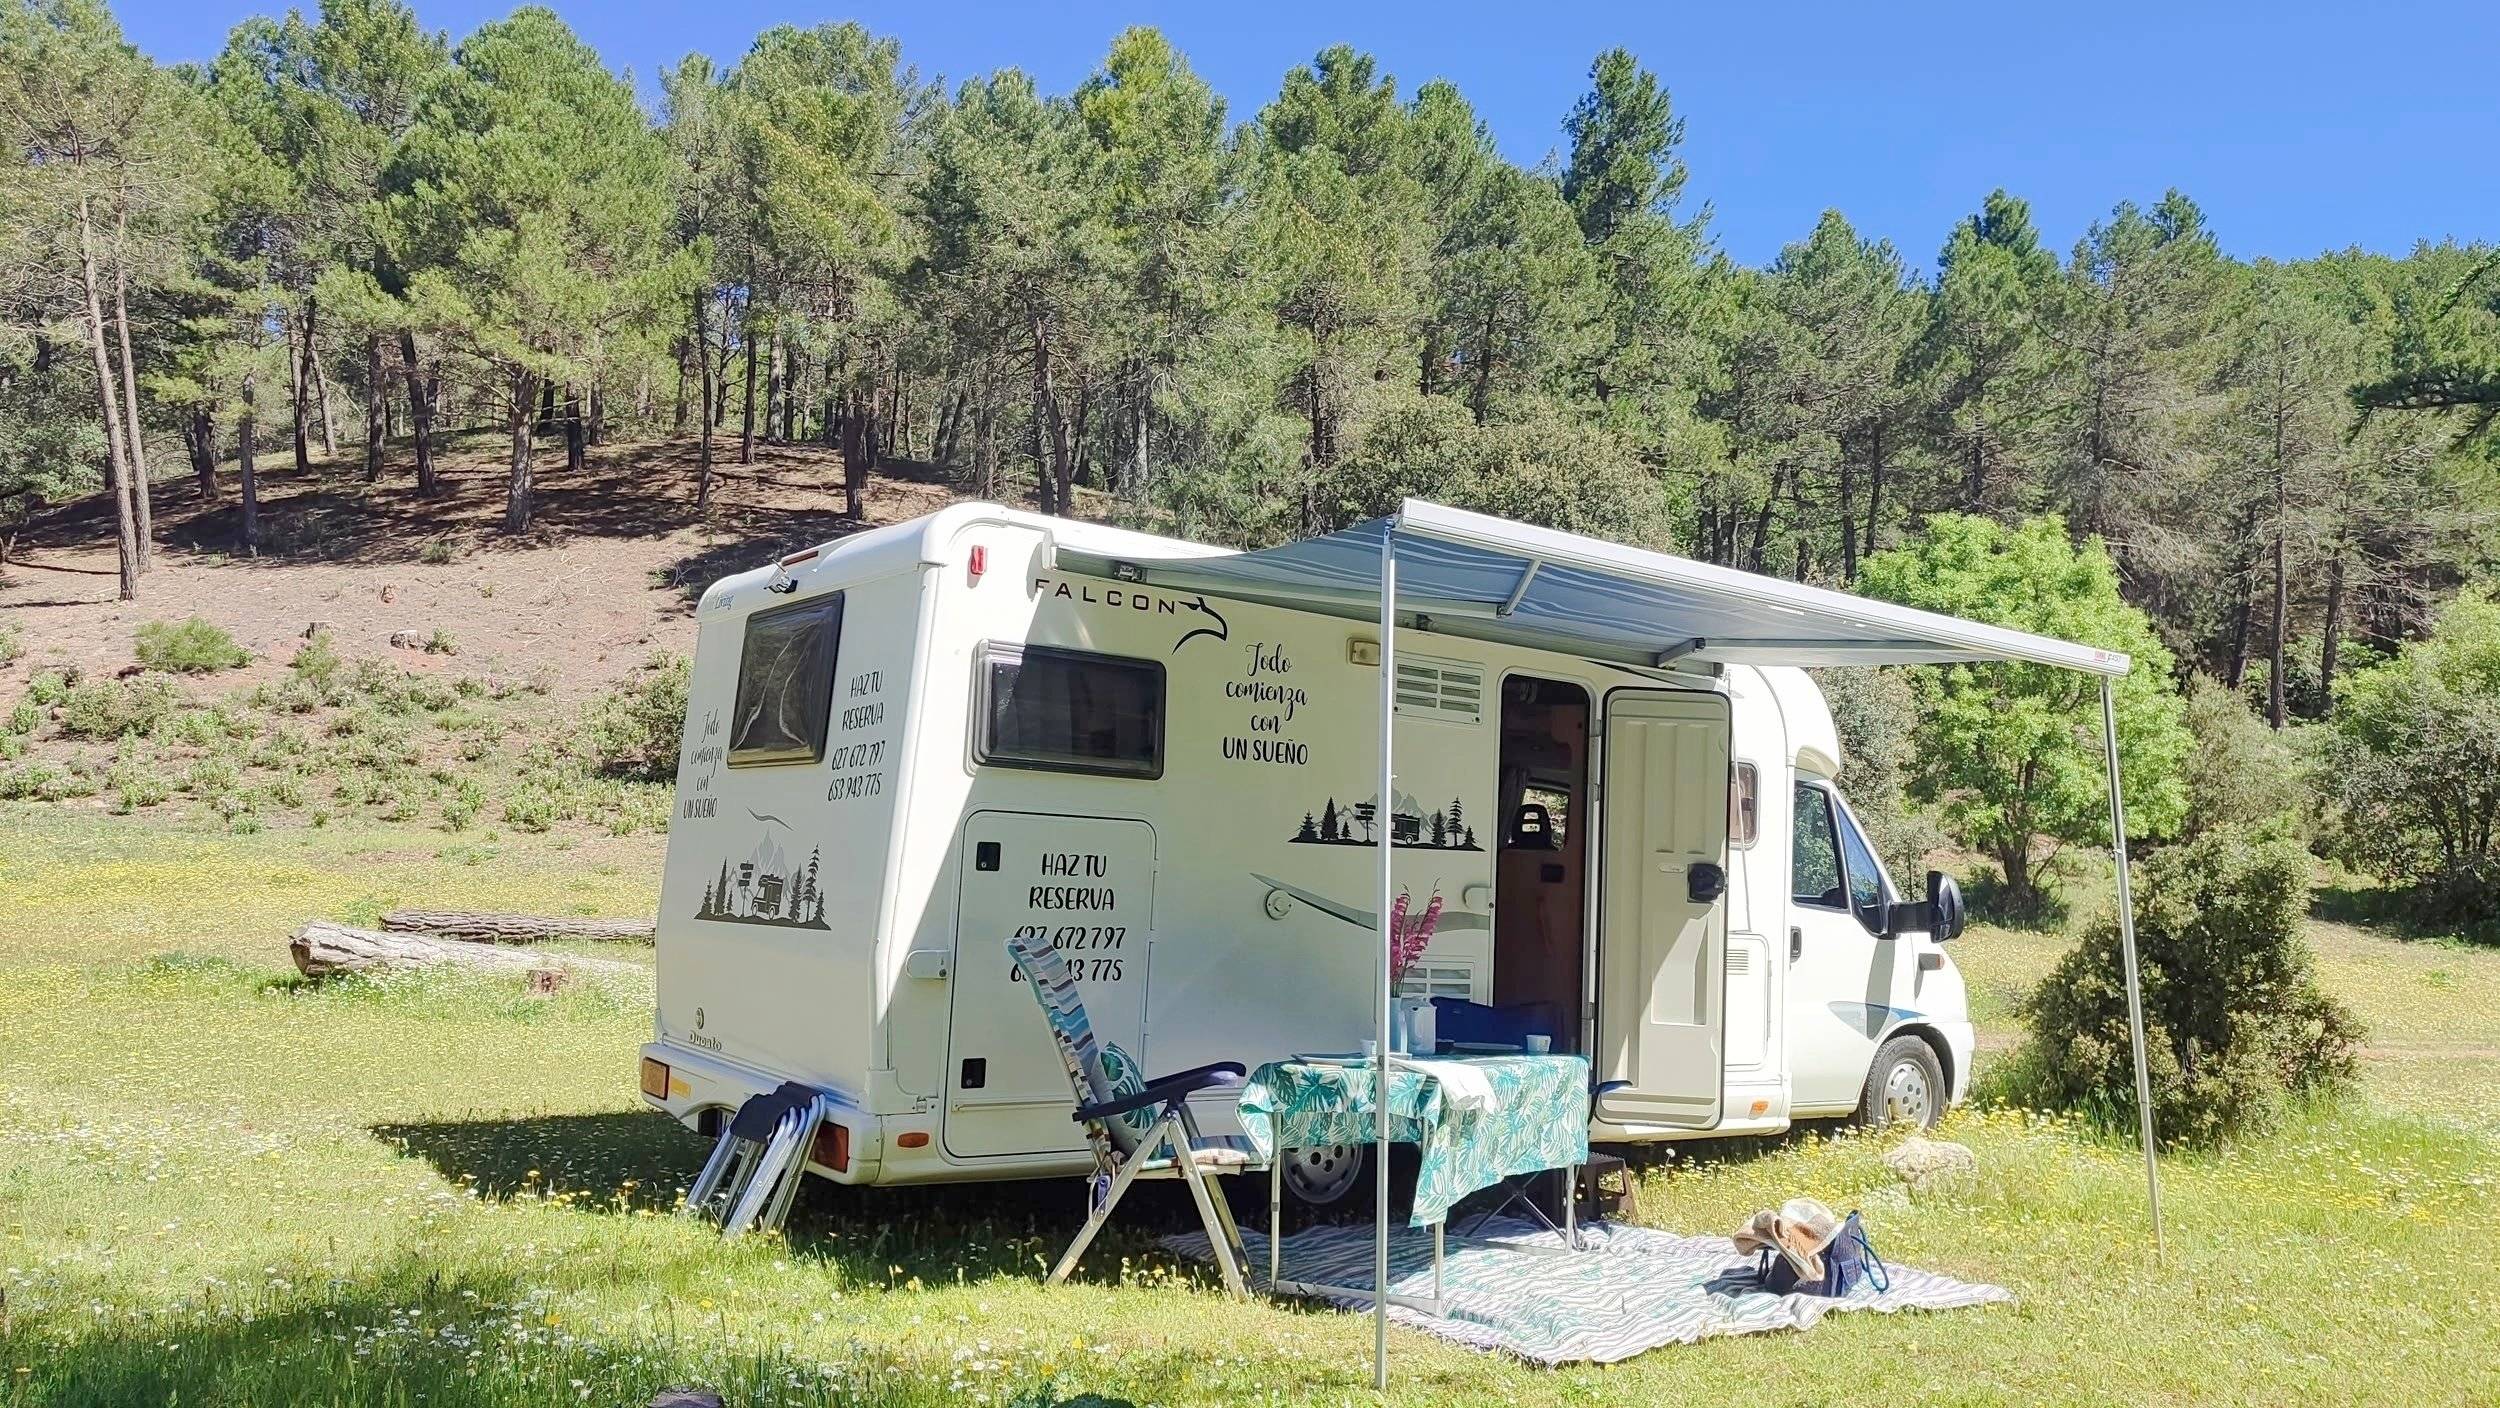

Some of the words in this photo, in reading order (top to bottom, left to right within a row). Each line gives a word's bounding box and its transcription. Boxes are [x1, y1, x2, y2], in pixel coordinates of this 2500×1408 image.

[1035, 578, 1175, 615] FALCON
[1245, 642, 1292, 677] Todo
[850, 673, 870, 699] HAZ
[871, 669, 884, 693] TU
[1225, 681, 1308, 722] comienza
[841, 702, 884, 731] RESERVA
[1250, 714, 1281, 735] con
[831, 746, 849, 771] 627
[849, 743, 867, 768] 672
[868, 740, 886, 766] 797
[1222, 736, 1248, 761] UN
[1252, 738, 1308, 765] SUEÑO
[827, 777, 845, 802] 653
[845, 775, 863, 800] 943
[864, 772, 883, 797] 775
[683, 799, 695, 819] UN
[1041, 853, 1080, 876] HAZ
[1083, 854, 1107, 878] TU
[1029, 885, 1115, 911] RESERVA
[1052, 926, 1087, 950] 672
[1091, 926, 1127, 950] 797
[1091, 958, 1124, 982] 775
